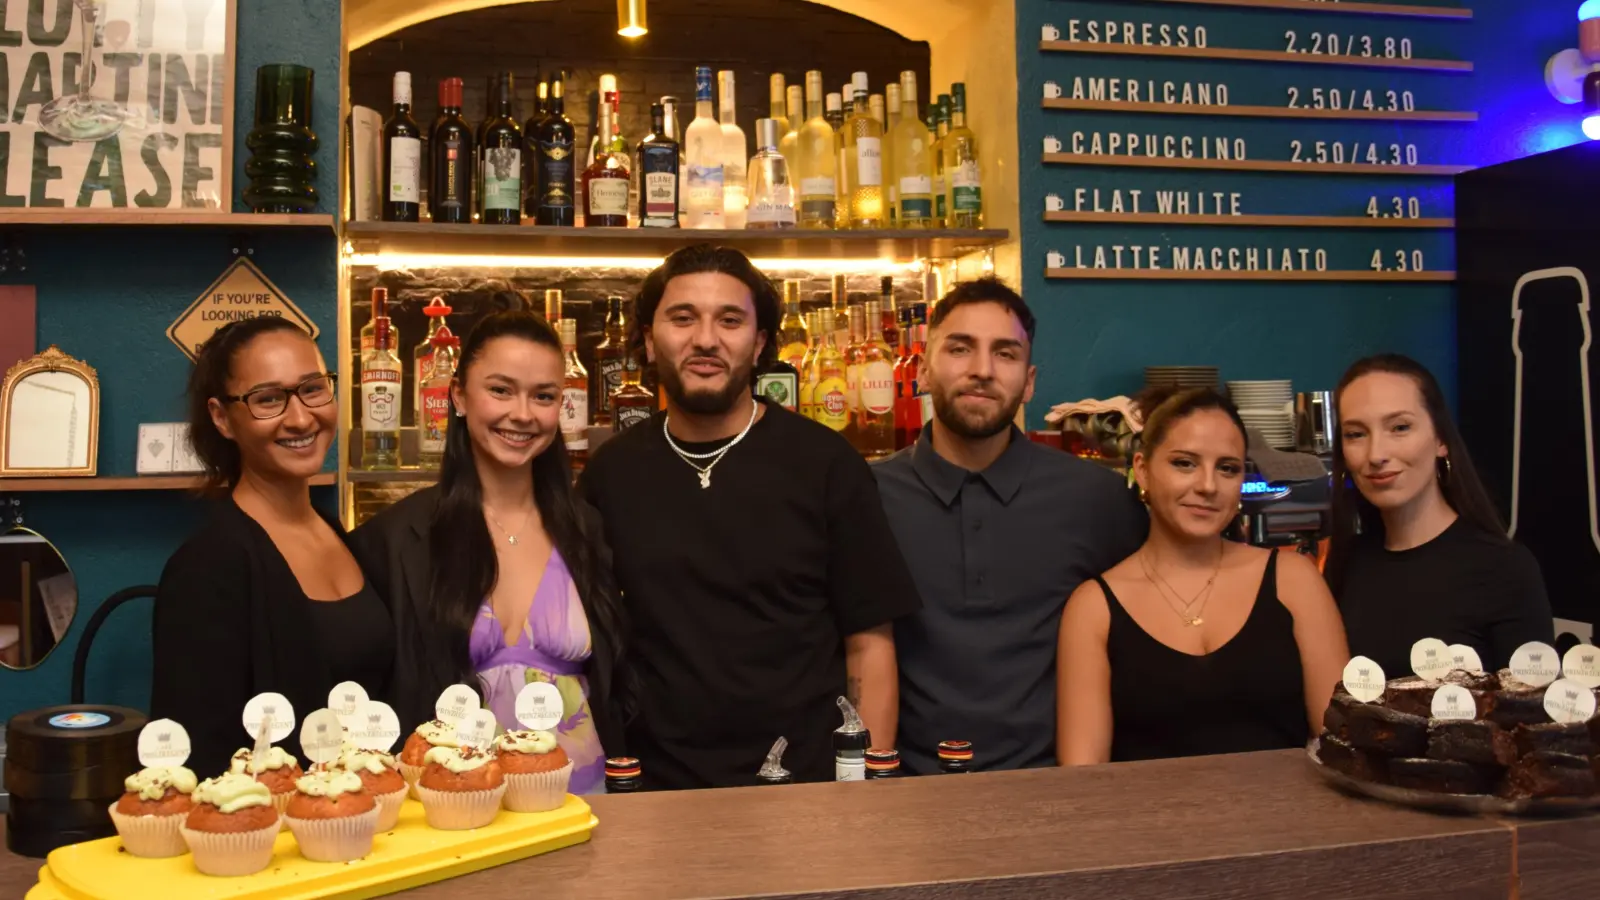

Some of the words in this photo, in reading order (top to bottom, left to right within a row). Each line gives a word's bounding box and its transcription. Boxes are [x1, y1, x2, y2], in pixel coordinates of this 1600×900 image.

[1069, 20, 1207, 49] ESPRESSO
[1285, 31, 1412, 60] 2.20/3.80
[0, 51, 224, 124] ARTINI
[1072, 77, 1228, 107] AMERICANO
[1287, 87, 1415, 112] 2.50/4.30
[1071, 131, 1247, 161] CAPPUCCINO
[1290, 140, 1418, 166] 2.50/4.30
[649, 175, 672, 184] SLANE
[1075, 188, 1142, 214] FLAT
[1156, 190, 1243, 217] WHITE
[1367, 196, 1420, 219] 4.30
[1075, 245, 1161, 270] LATTE
[1173, 246, 1327, 272] MACCHIATO
[1370, 249, 1424, 272] 4.30
[213, 294, 224, 304] IF
[227, 293, 271, 304] YOU'RE
[202, 310, 254, 321] LOOKING
[862, 380, 892, 389] LILLET
